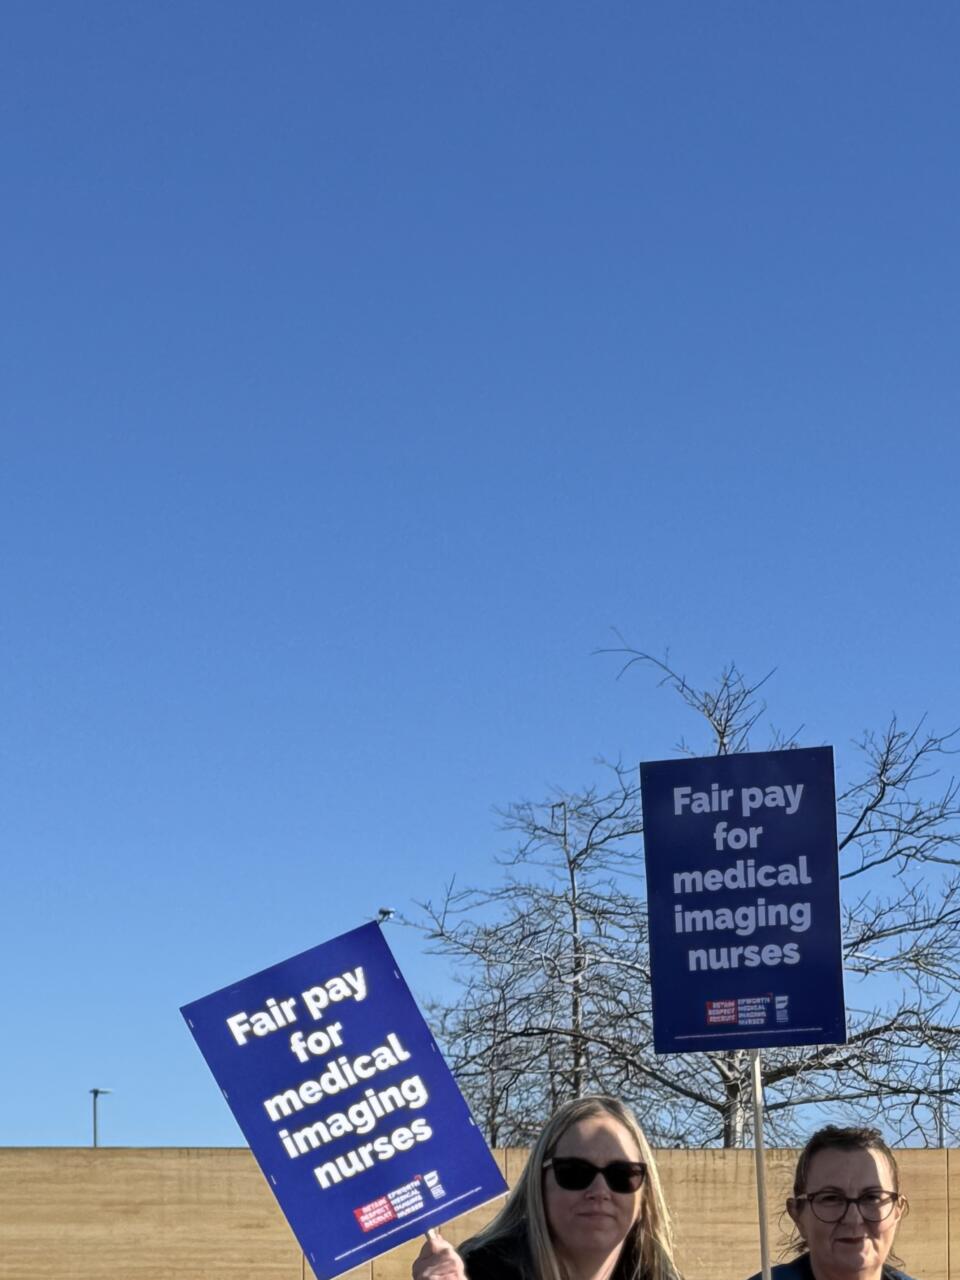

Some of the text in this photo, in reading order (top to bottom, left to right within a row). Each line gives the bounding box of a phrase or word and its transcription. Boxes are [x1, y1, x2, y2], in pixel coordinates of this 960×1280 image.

[673, 784, 805, 817] Fair pay
[713, 822, 763, 850] for
[673, 856, 813, 894] medical
[674, 898, 812, 937] imaging
[688, 943, 801, 972] nurses
[226, 967, 368, 1046] Fair pay
[290, 1022, 344, 1063] for
[263, 1032, 412, 1122] medical
[278, 1074, 429, 1159] imaging
[313, 1117, 433, 1190] nurses
